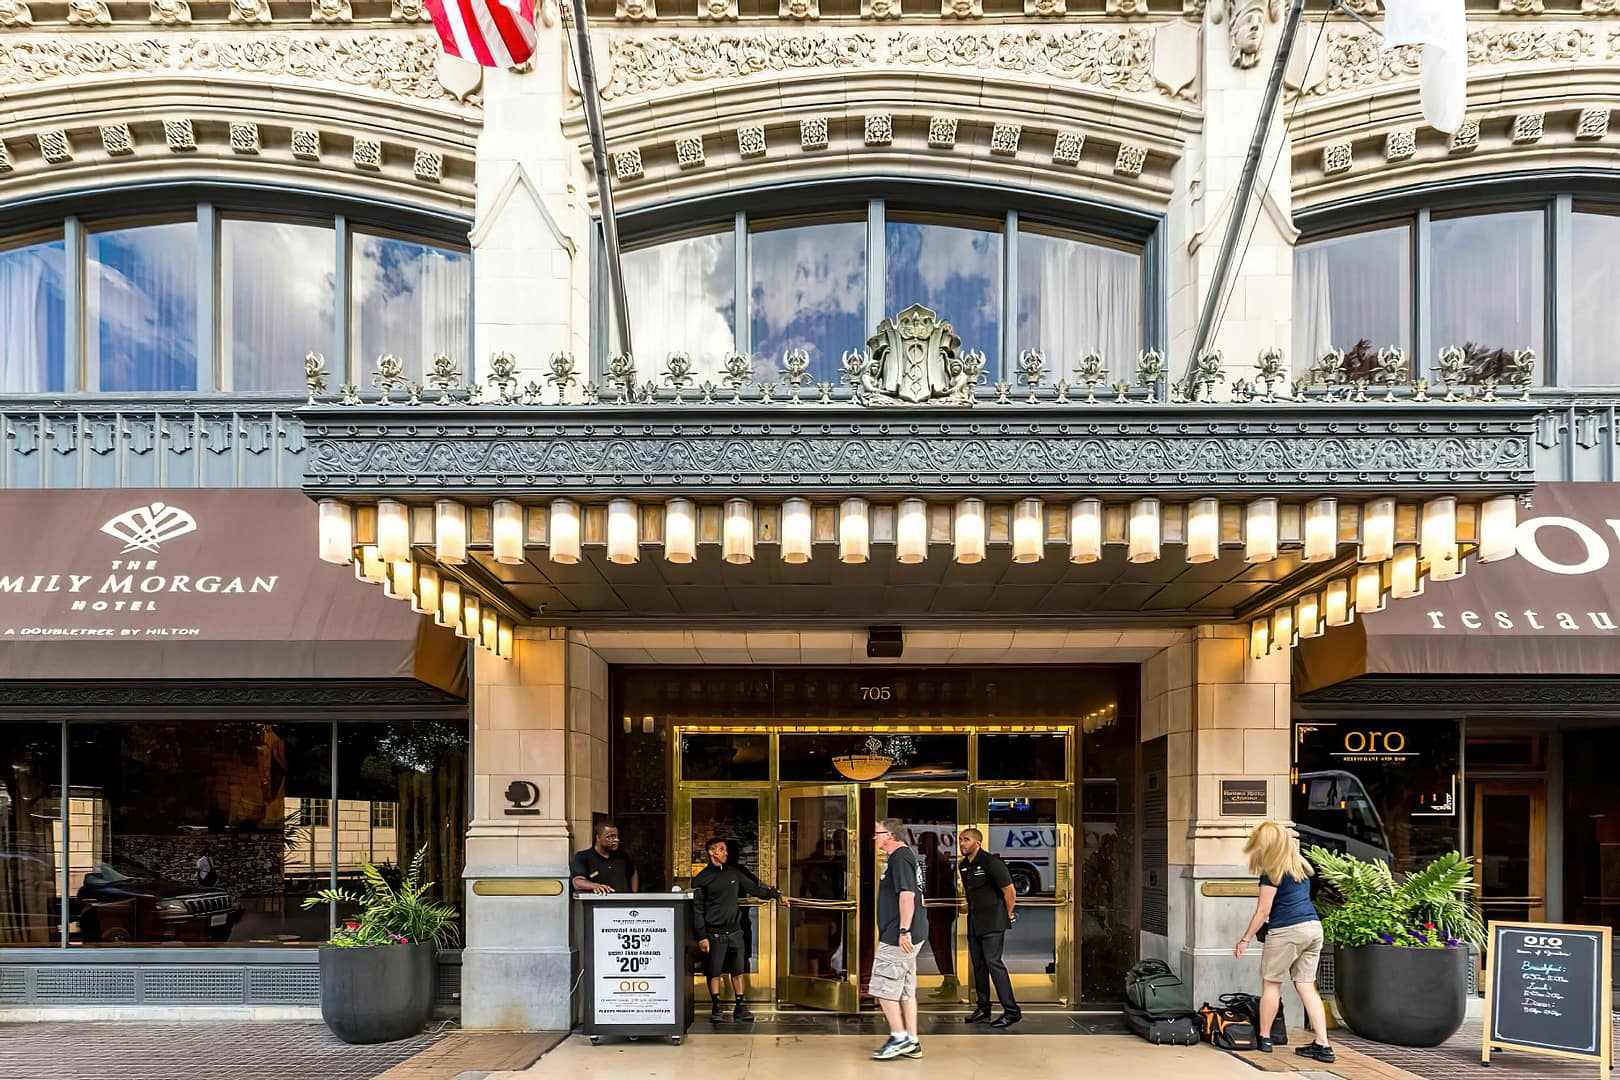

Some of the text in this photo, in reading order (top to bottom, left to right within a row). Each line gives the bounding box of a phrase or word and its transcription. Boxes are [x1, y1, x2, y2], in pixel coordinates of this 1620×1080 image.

[111, 560, 158, 570] THE
[97, 574, 279, 594] MORGAN
[71, 601, 157, 611] HOTEL
[1426, 608, 1618, 631] restau
[20, 627, 115, 636] DOUBLETREE
[120, 628, 143, 636] BY
[145, 628, 200, 636] HILTON
[860, 686, 891, 701] 705
[1344, 730, 1406, 752] oro
[1523, 935, 1563, 946] oro
[619, 980, 650, 992] oro
